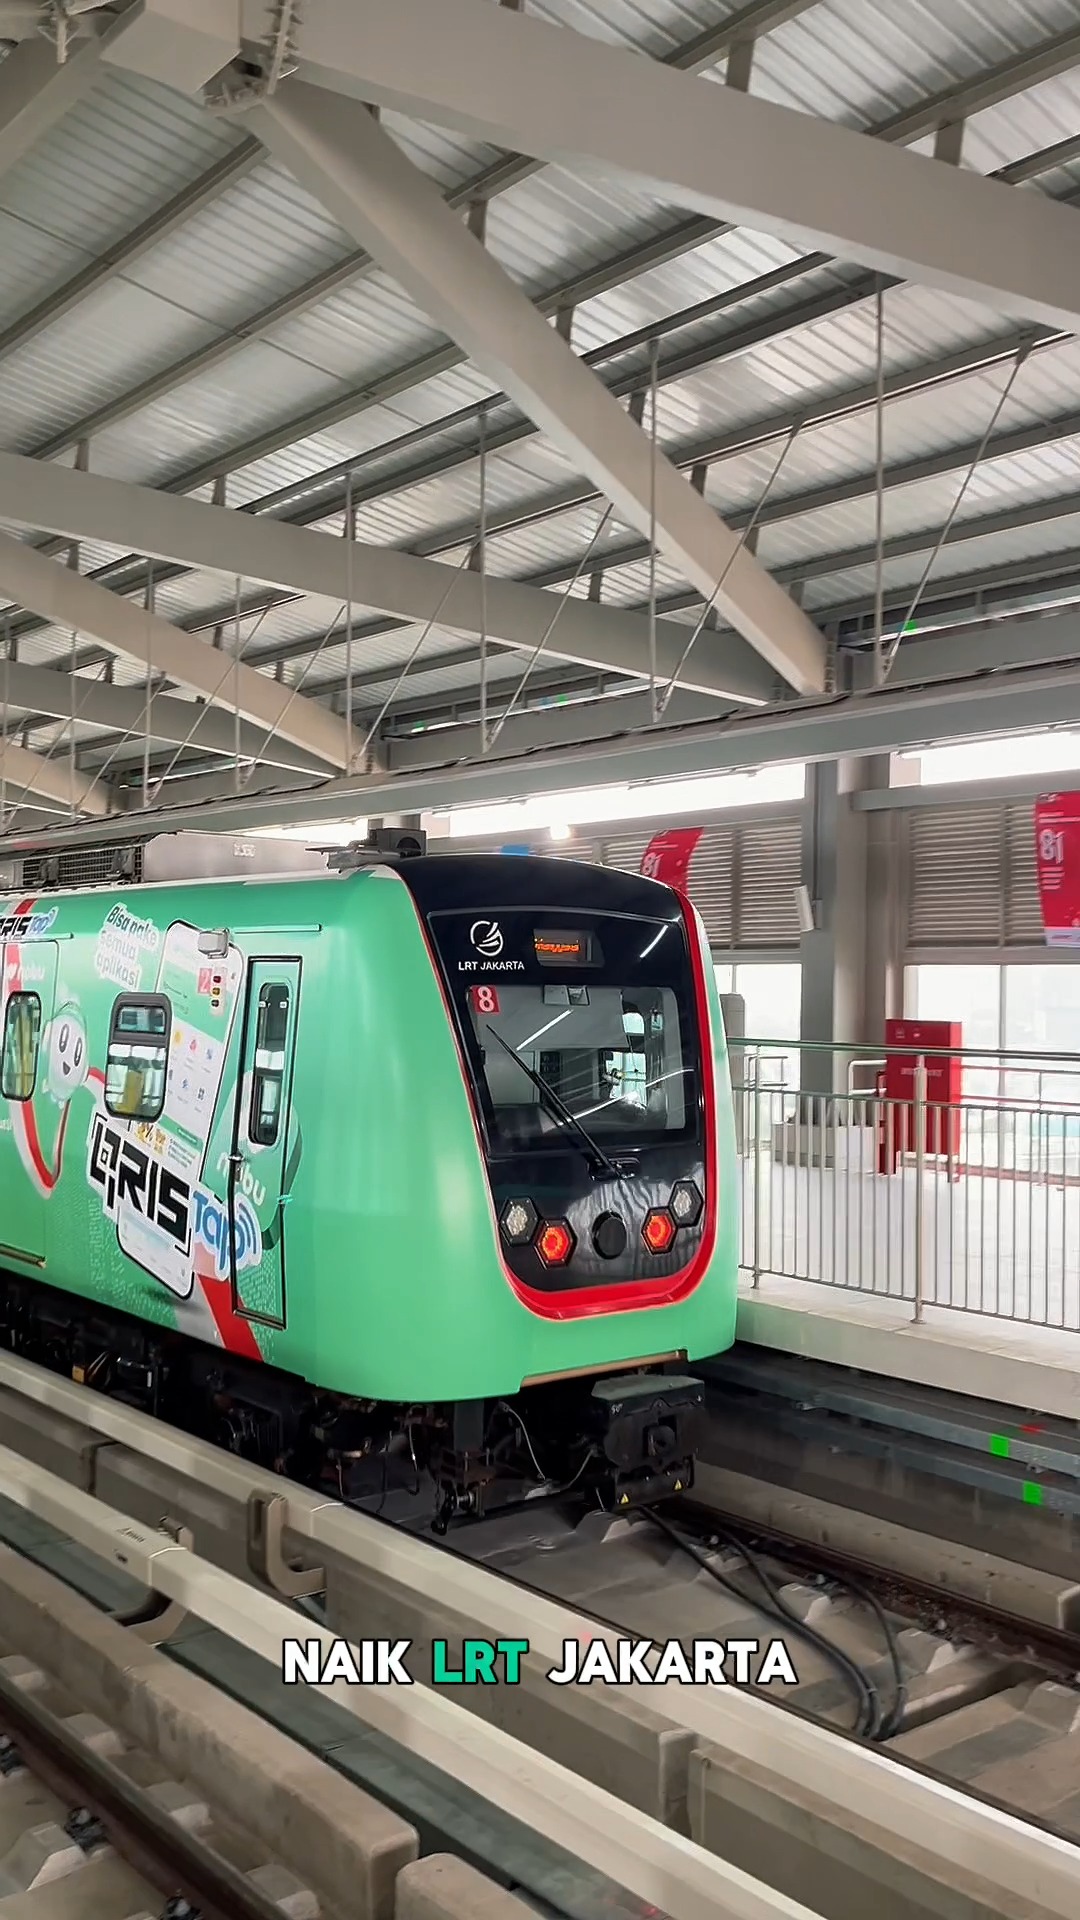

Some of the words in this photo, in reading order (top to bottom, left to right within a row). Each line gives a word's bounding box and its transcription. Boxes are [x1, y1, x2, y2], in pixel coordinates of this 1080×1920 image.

[1039, 829, 1064, 864] 81
[107, 906, 130, 930] Bisa
[458, 961, 478, 971] LRT
[480, 961, 525, 971] JAKARTA
[477, 986, 495, 1012] 8
[90, 1121, 191, 1245] QRIS
[193, 1190, 246, 1271] Tap
